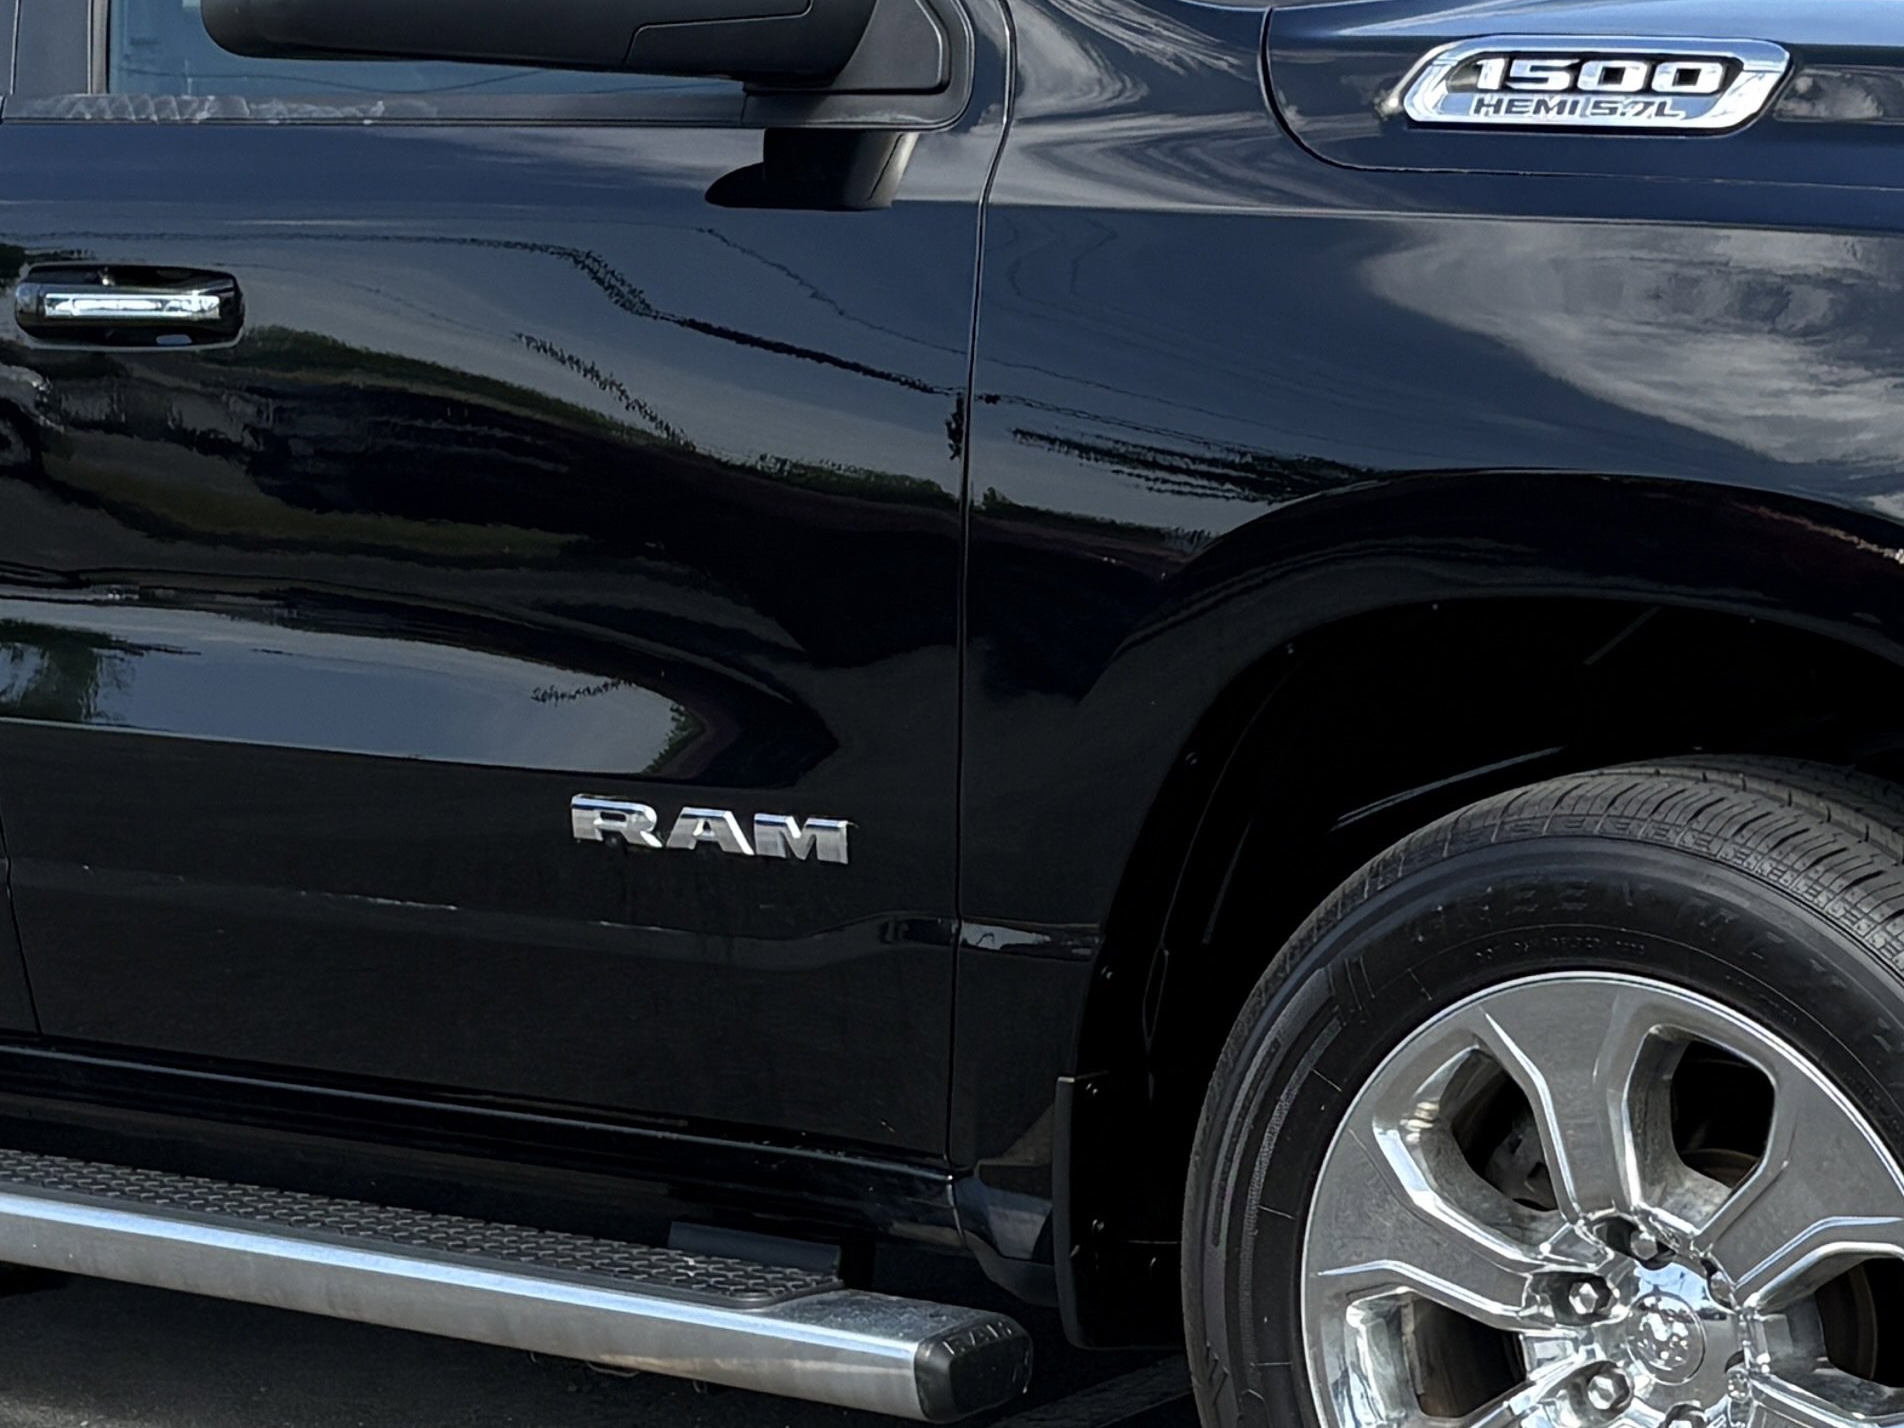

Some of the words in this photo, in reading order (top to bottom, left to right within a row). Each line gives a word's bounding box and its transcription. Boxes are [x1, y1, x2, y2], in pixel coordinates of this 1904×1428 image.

[1474, 58, 1724, 93] 1500
[1472, 97, 1582, 117] HEMI
[1589, 99, 1684, 118] 5.7L
[571, 793, 849, 865] RAM
